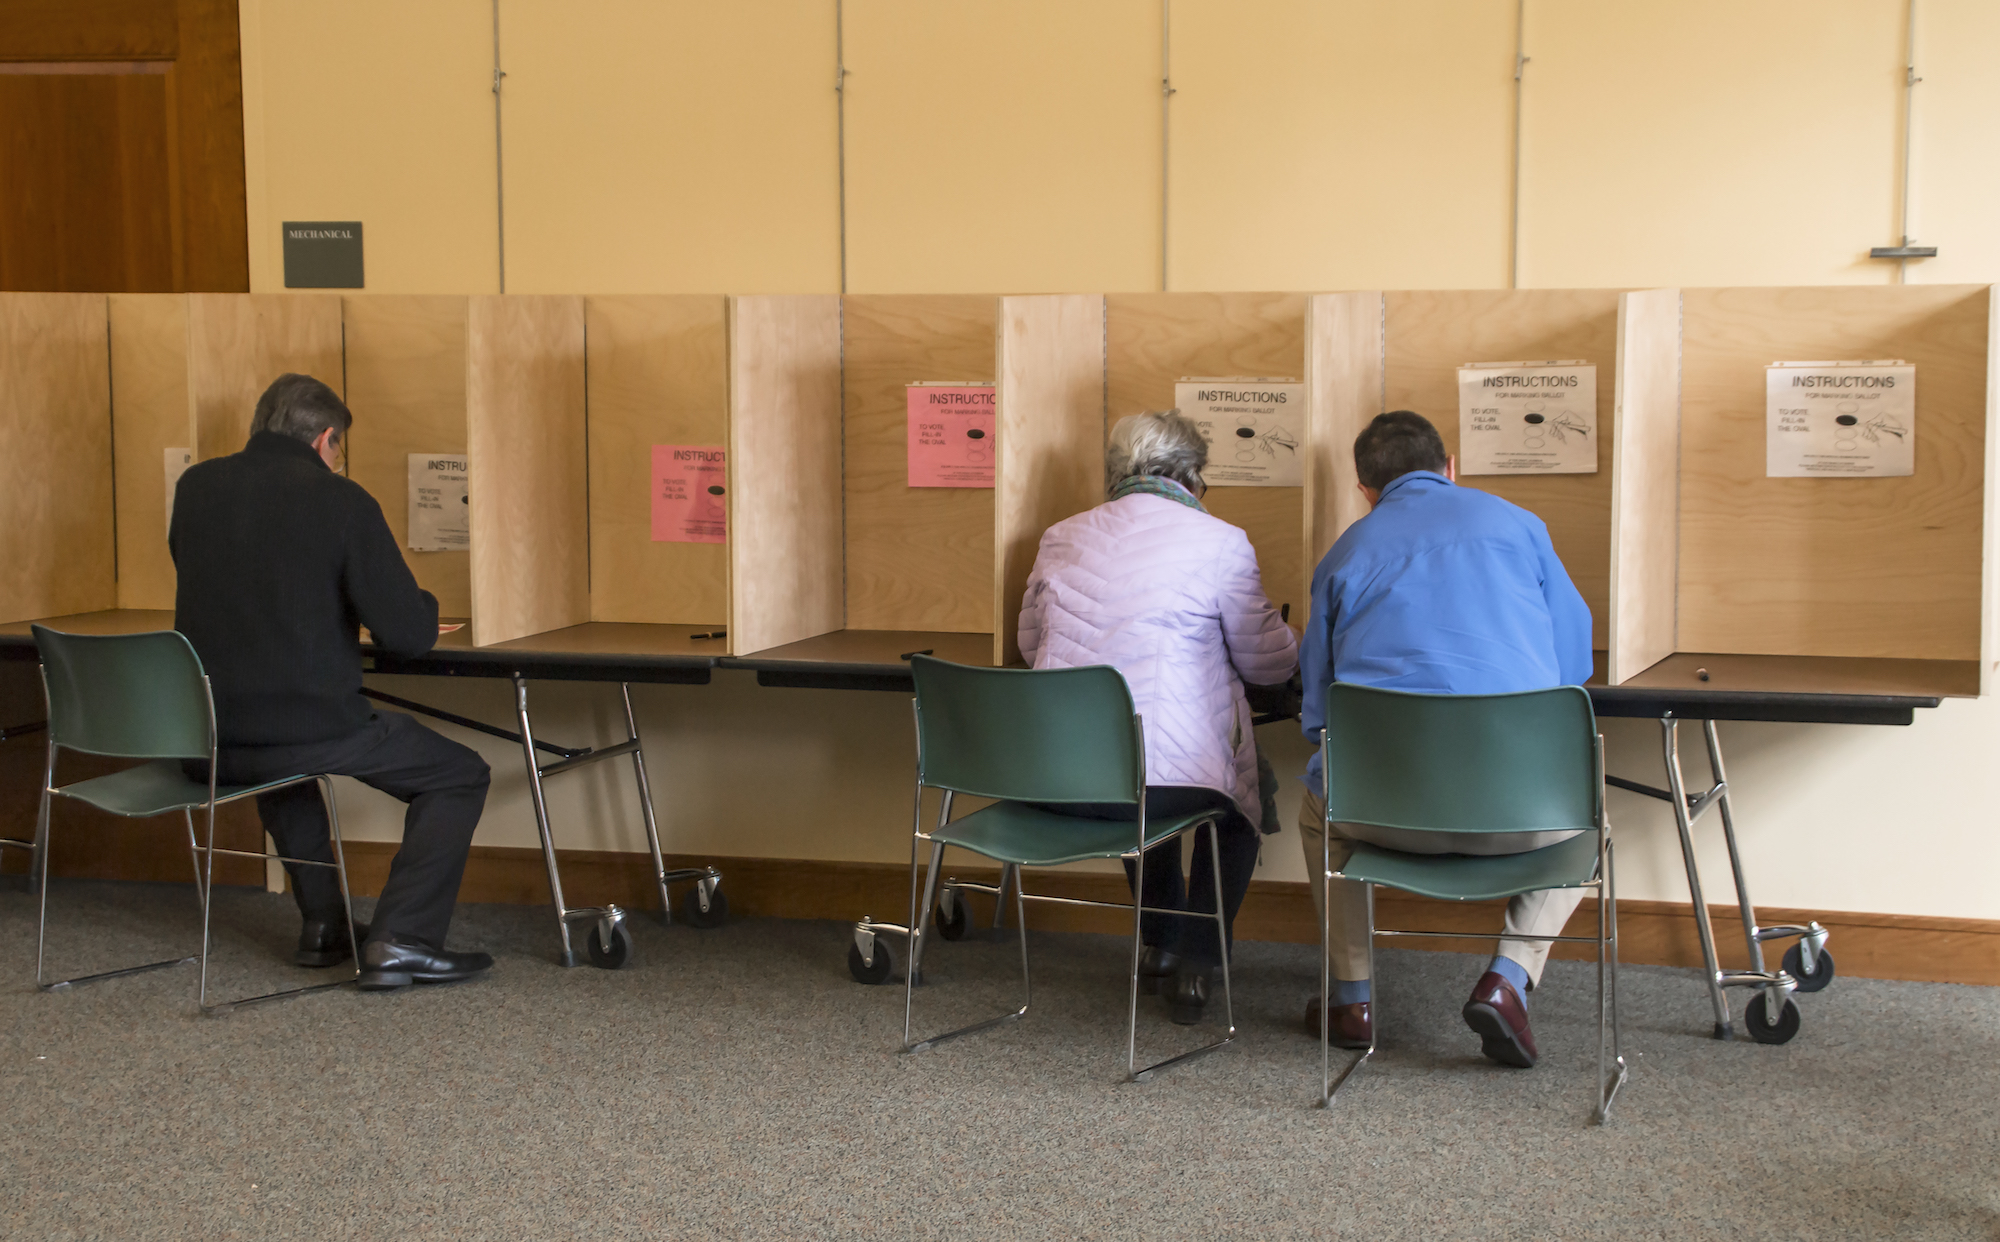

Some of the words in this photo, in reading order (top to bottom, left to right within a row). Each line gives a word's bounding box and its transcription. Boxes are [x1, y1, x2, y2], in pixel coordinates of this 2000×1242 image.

[289, 229, 353, 239] MECHANICAL
[1483, 375, 1578, 388] INSTRUCTIONS
[1792, 375, 1895, 389] INSTRUCTIONS
[1198, 390, 1287, 404] INSTRUCTIONS
[1510, 391, 1541, 399] MARKING
[1541, 391, 1565, 399] BALLOT
[1855, 392, 1881, 400] BALLOT
[941, 408, 953, 416] FOR
[954, 408, 980, 416] MARKING
[1223, 406, 1252, 414] MARKING
[1778, 408, 1788, 416] TO
